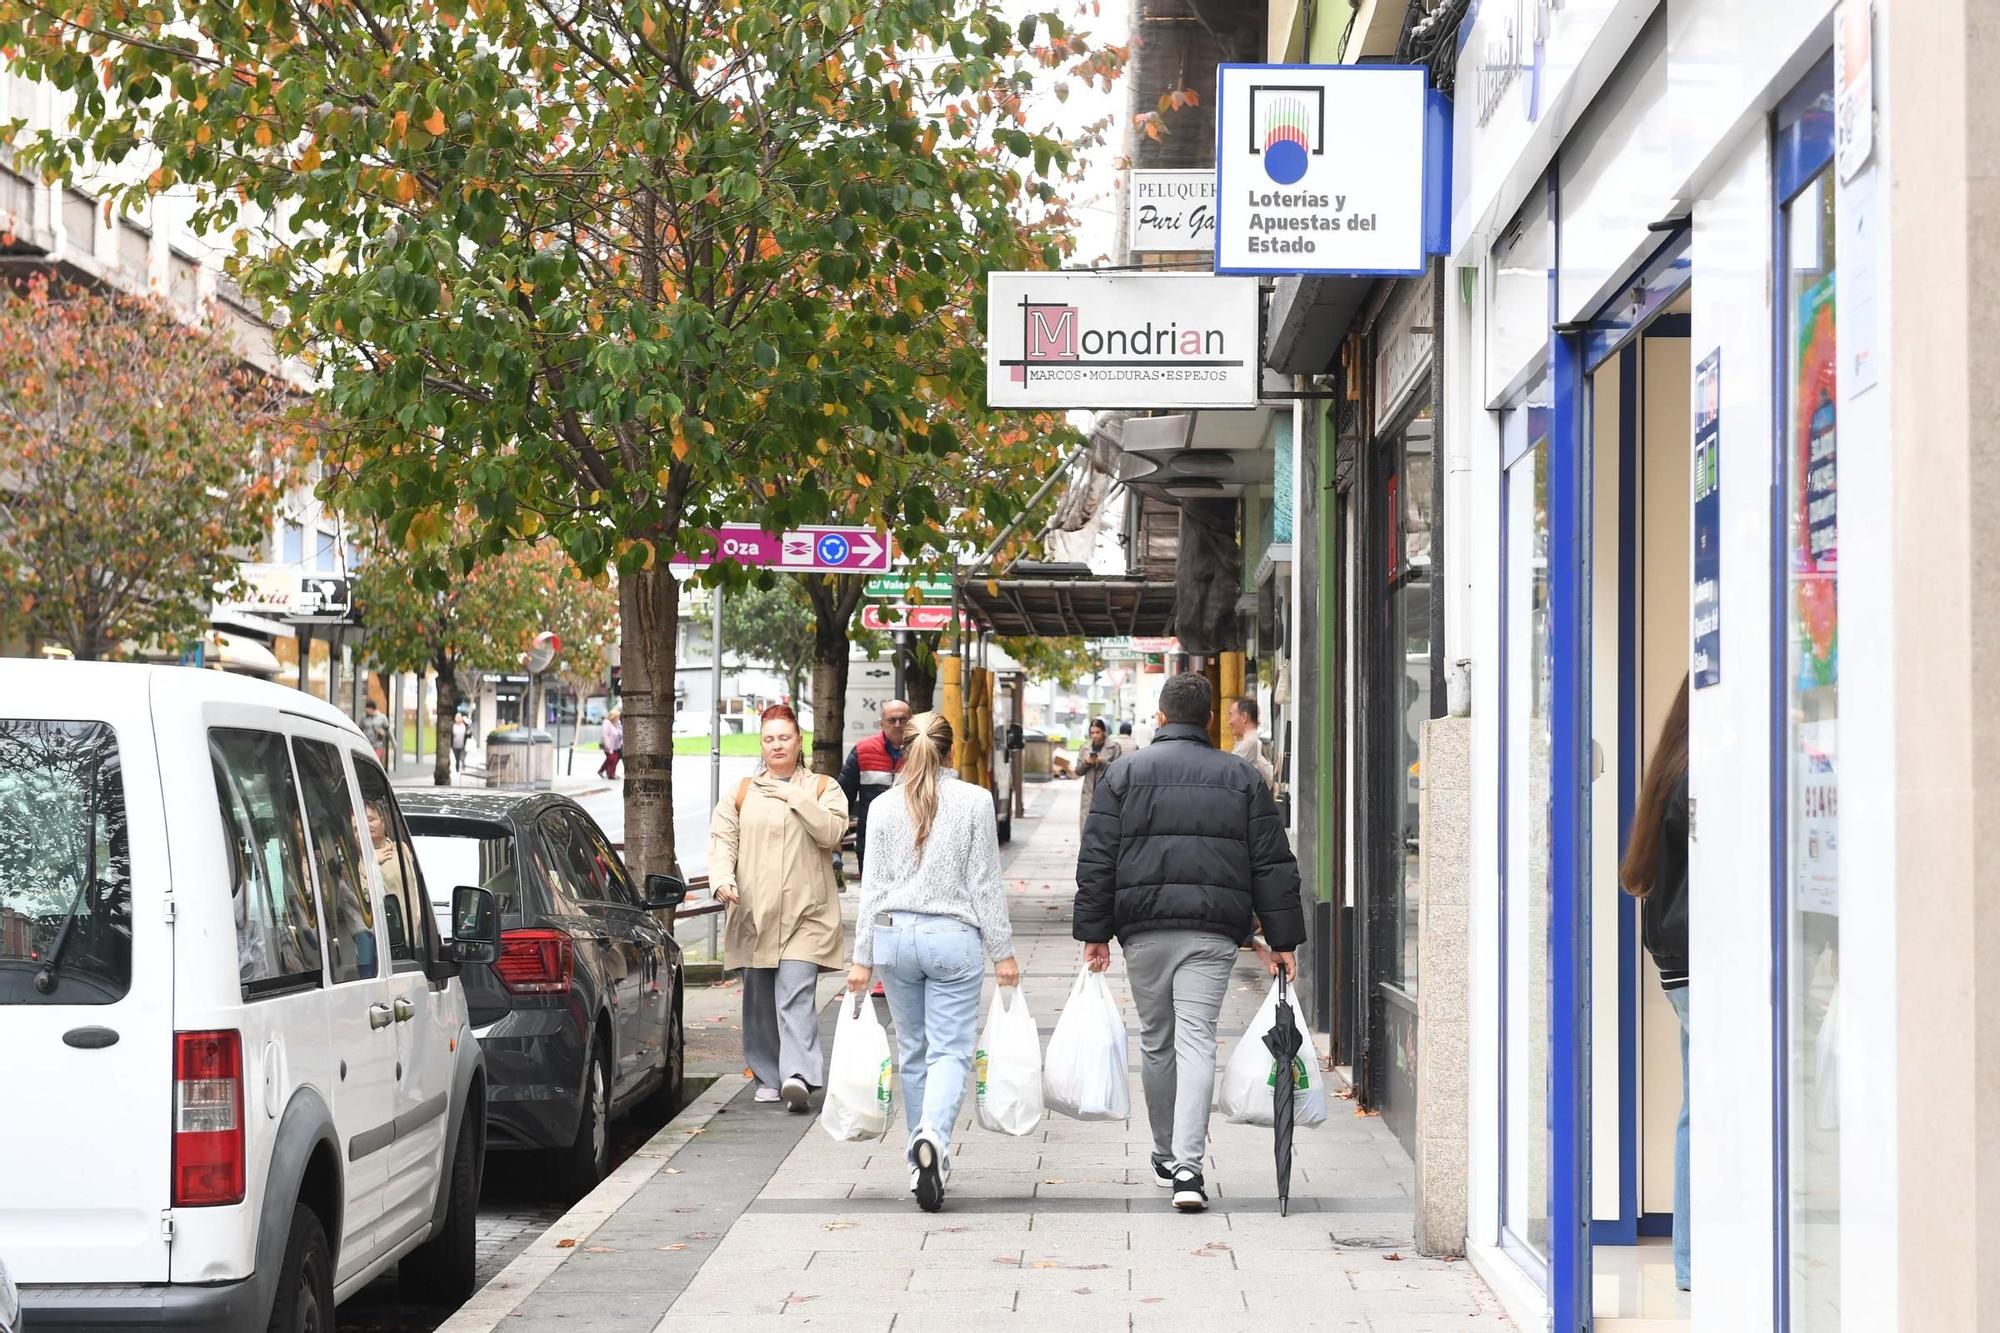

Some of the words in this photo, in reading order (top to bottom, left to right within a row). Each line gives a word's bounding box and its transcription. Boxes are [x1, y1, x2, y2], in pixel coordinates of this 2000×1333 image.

[1249, 190, 1329, 207] Loterías
[1335, 195, 1346, 212] y
[1138, 205, 1182, 231] Puri
[1249, 213, 1341, 234] Apuestas
[1347, 213, 1376, 231] del
[1248, 236, 1316, 253] Estado
[1030, 311, 1224, 357] Mondrian
[723, 538, 760, 556] Oza
